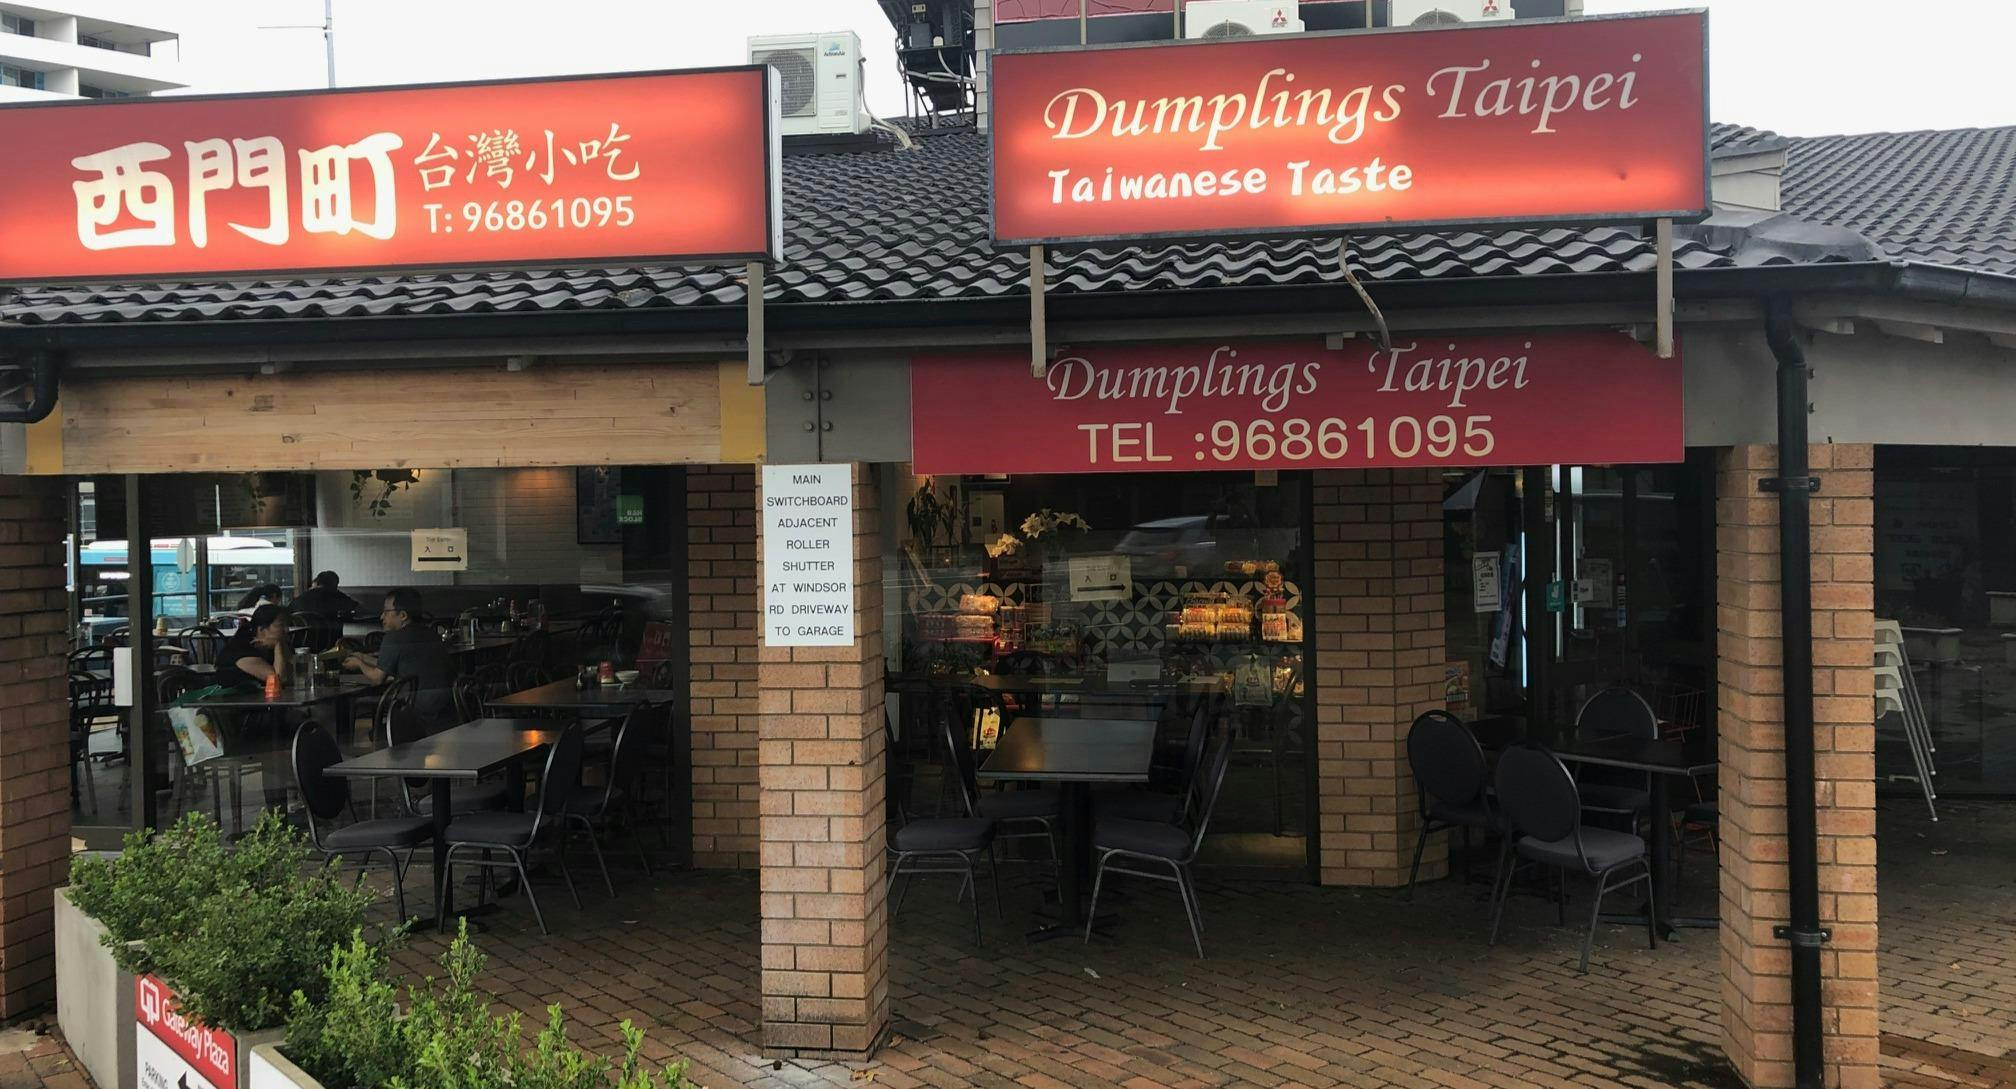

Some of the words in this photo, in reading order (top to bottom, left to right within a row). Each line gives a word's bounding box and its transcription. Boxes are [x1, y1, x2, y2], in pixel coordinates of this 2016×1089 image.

[1044, 68, 1405, 152] Dumplings
[1427, 53, 1641, 134] Taipei
[414, 122, 640, 192] 台灣小吃
[72, 132, 403, 251] 西門町
[1048, 164, 1267, 205] Taiwanese
[1286, 155, 1414, 196] Taste
[422, 203, 453, 234] T:
[459, 196, 635, 232] 96861095
[1045, 347, 1321, 414] Dumplings
[1369, 342, 1532, 408] Taipei
[1078, 422, 1173, 464] TEL
[792, 474, 822, 485] MAIN
[766, 495, 849, 507] SWITCHBOARD
[777, 517, 839, 528] ADJACENT
[786, 539, 830, 550] ROLLER
[782, 560, 835, 572] SHUTTER
[771, 583, 786, 593] AT
[793, 582, 847, 593] WINDSOR
[769, 604, 785, 615] RD
[791, 604, 849, 615] DRIVEWAY
[775, 626, 791, 636] TO
[797, 625, 844, 636] GARAGE
[204, 1030, 229, 1074] Plaza
